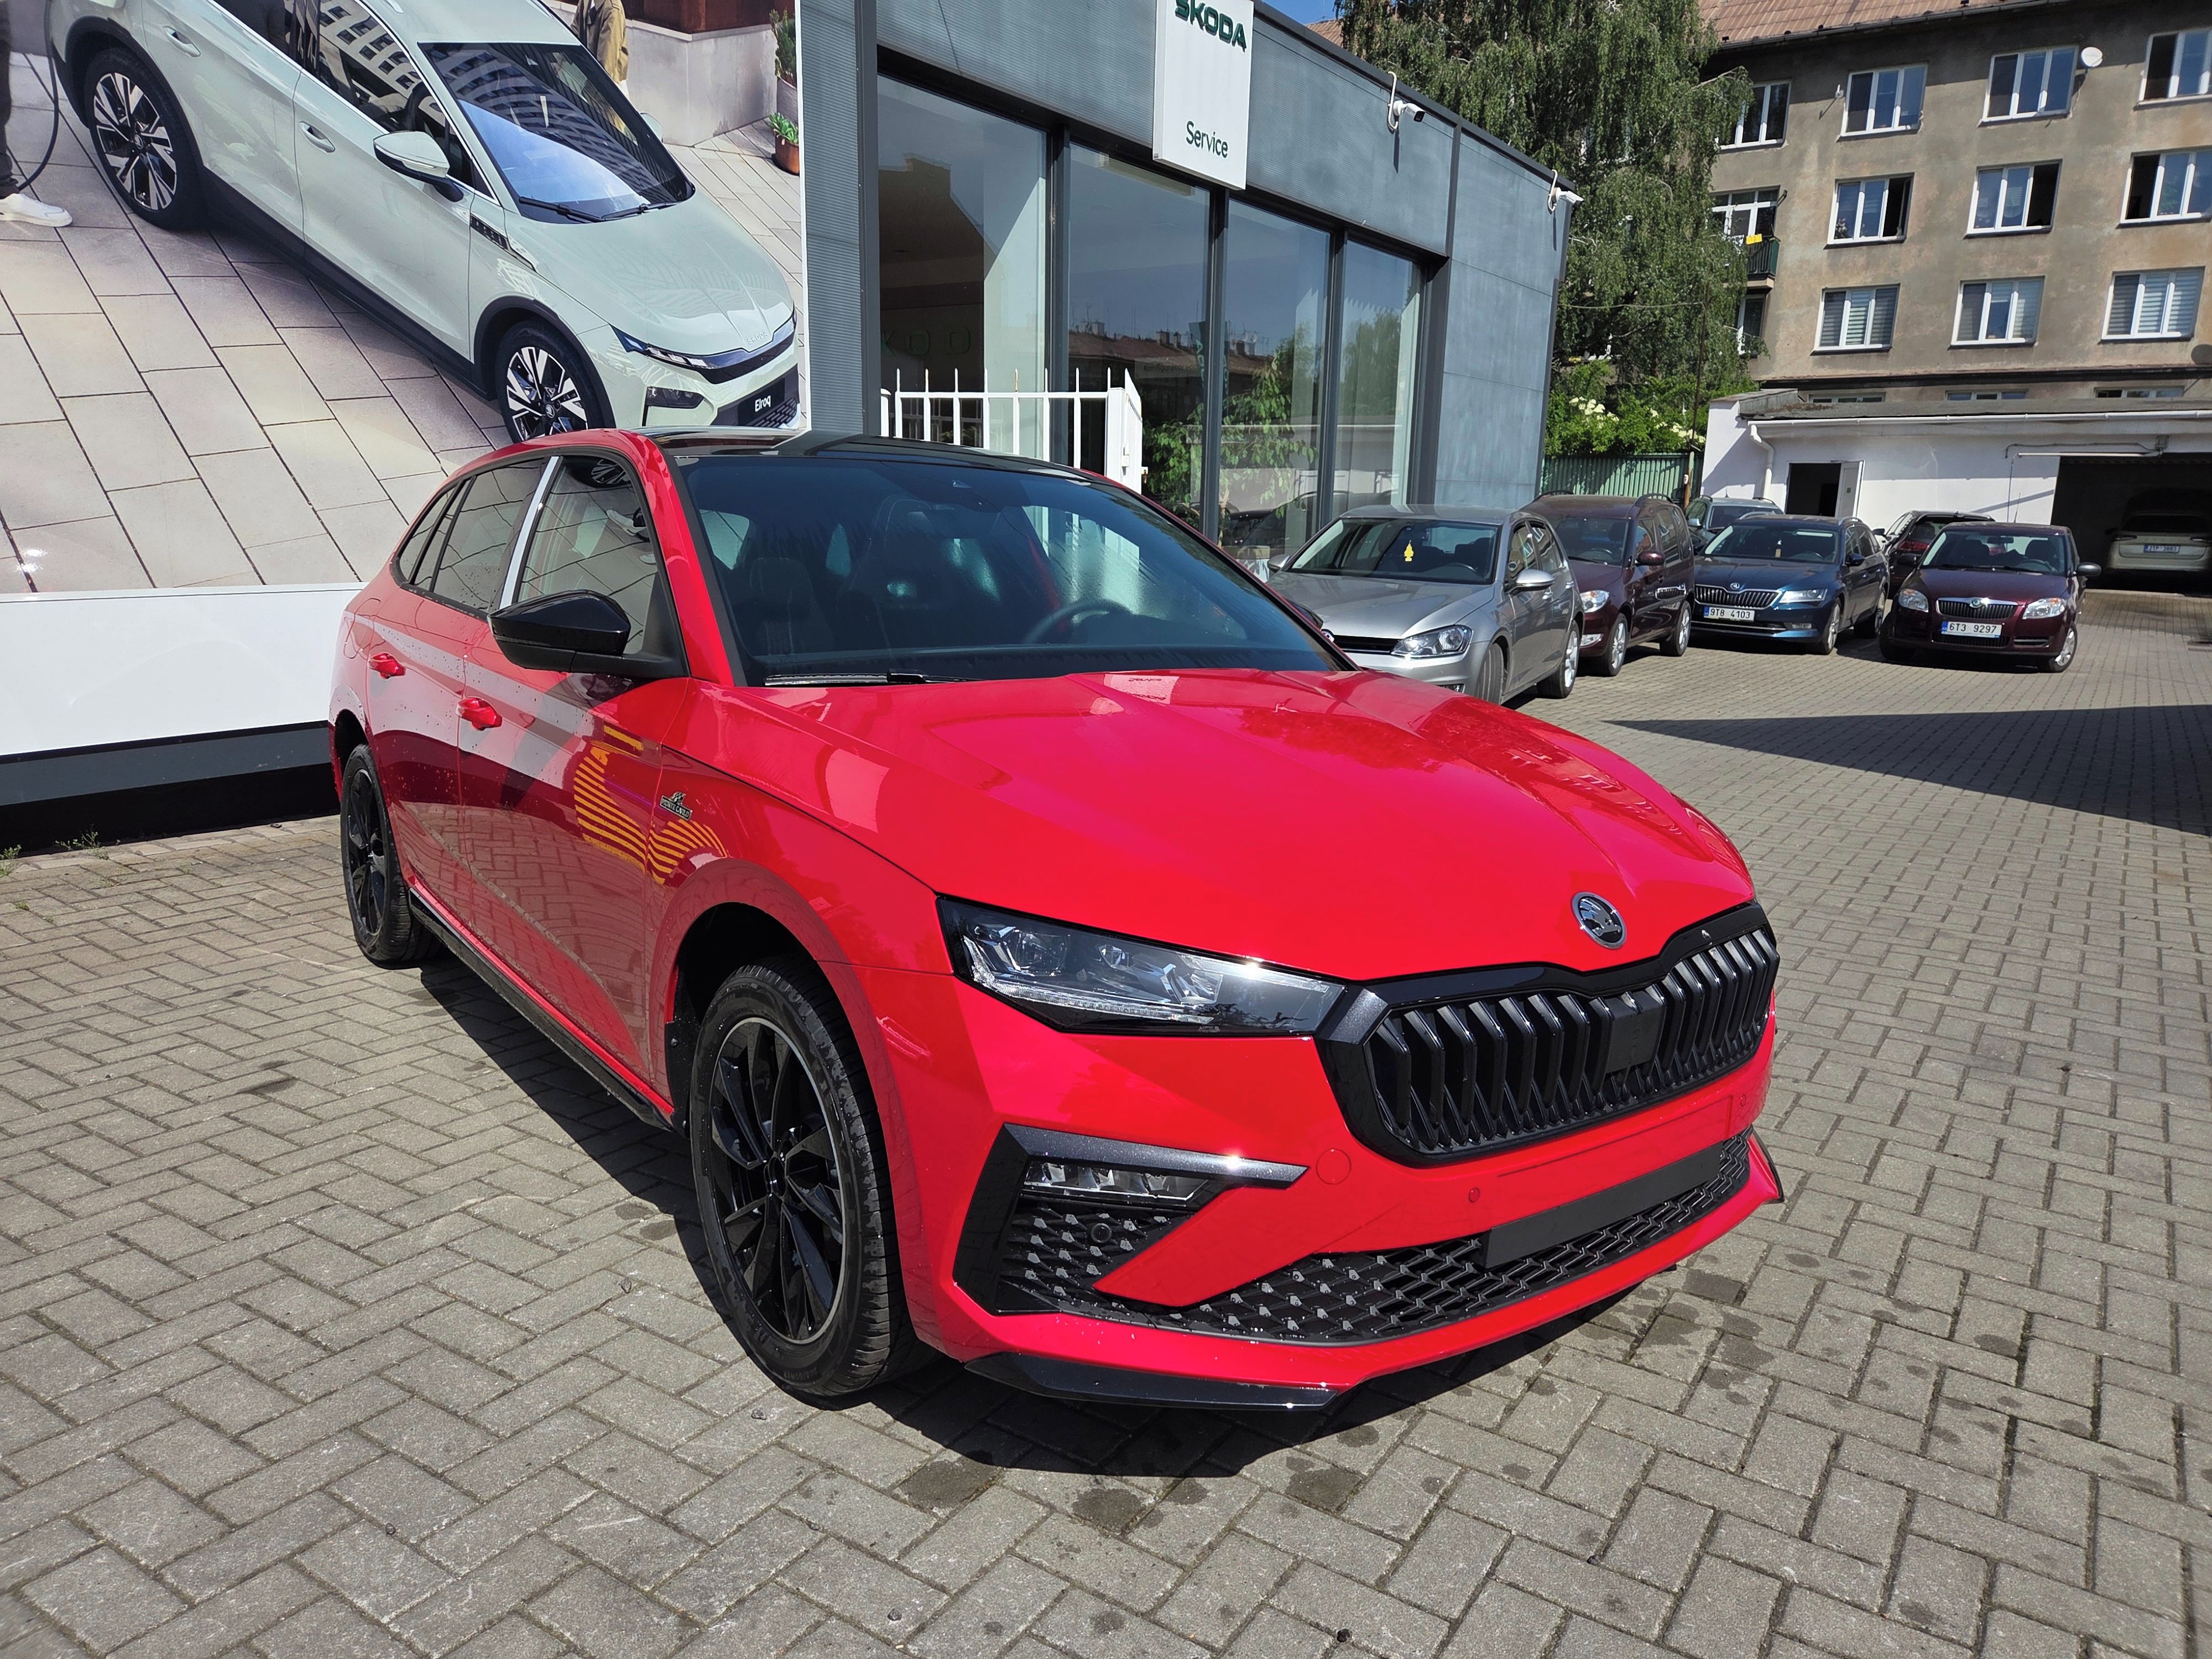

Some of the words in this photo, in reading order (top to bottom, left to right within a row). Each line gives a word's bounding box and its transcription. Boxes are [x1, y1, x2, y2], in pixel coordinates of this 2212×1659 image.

[1186, 121, 1228, 158] Service
[755, 395, 771, 412] Elroq
[1730, 611, 1750, 619] 4103
[1949, 623, 1966, 632] 6T3
[1974, 624, 1997, 634] 9297
